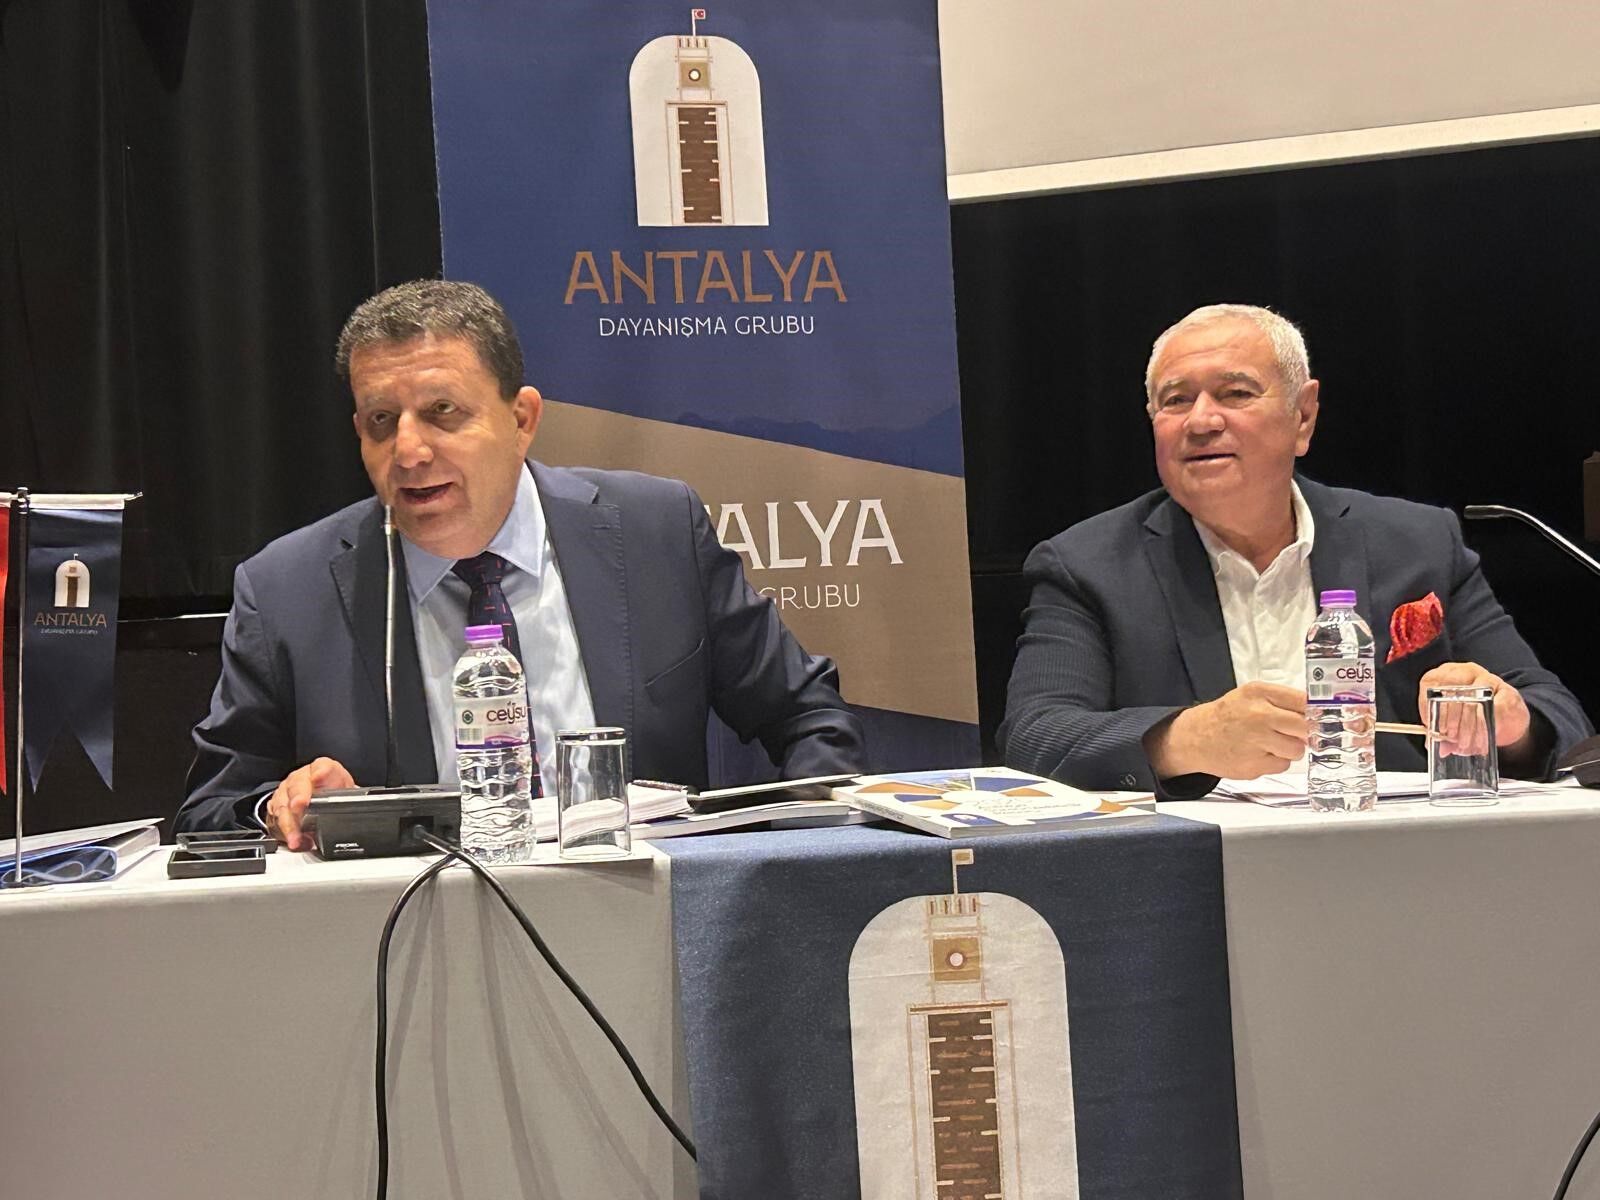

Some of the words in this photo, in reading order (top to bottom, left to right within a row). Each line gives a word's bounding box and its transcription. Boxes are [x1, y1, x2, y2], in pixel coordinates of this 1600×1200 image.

[563, 250, 848, 304] ANTALYA
[599, 317, 727, 338] DAYANIŞMA
[734, 315, 814, 335] GRUBU
[704, 499, 904, 570] ALYA
[34, 612, 107, 628] ANTALYA
[1336, 661, 1374, 683] ceys
